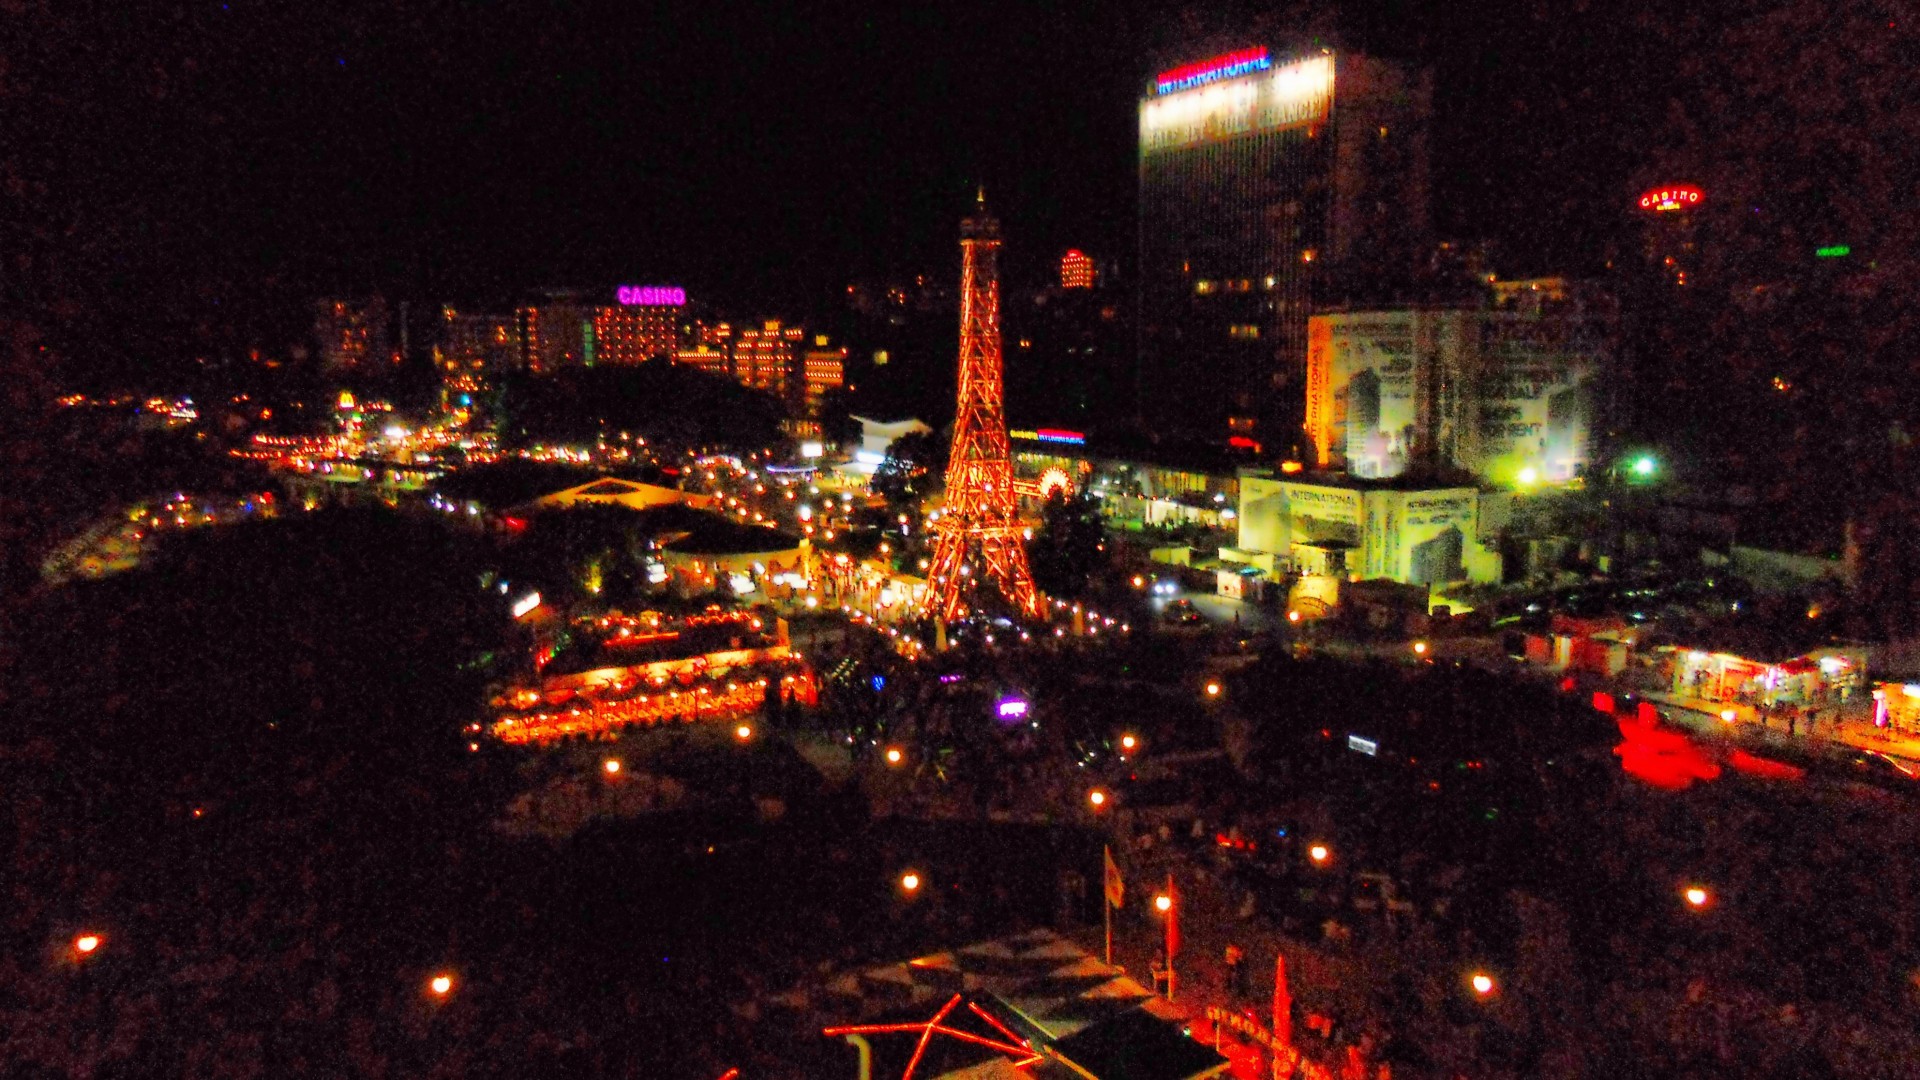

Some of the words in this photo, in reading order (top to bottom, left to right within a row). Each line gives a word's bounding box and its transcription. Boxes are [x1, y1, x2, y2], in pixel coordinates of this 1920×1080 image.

[1157, 46, 1271, 95] INTERNATIONAL
[1641, 191, 1699, 207] CASINO
[617, 286, 687, 306] CASINO
